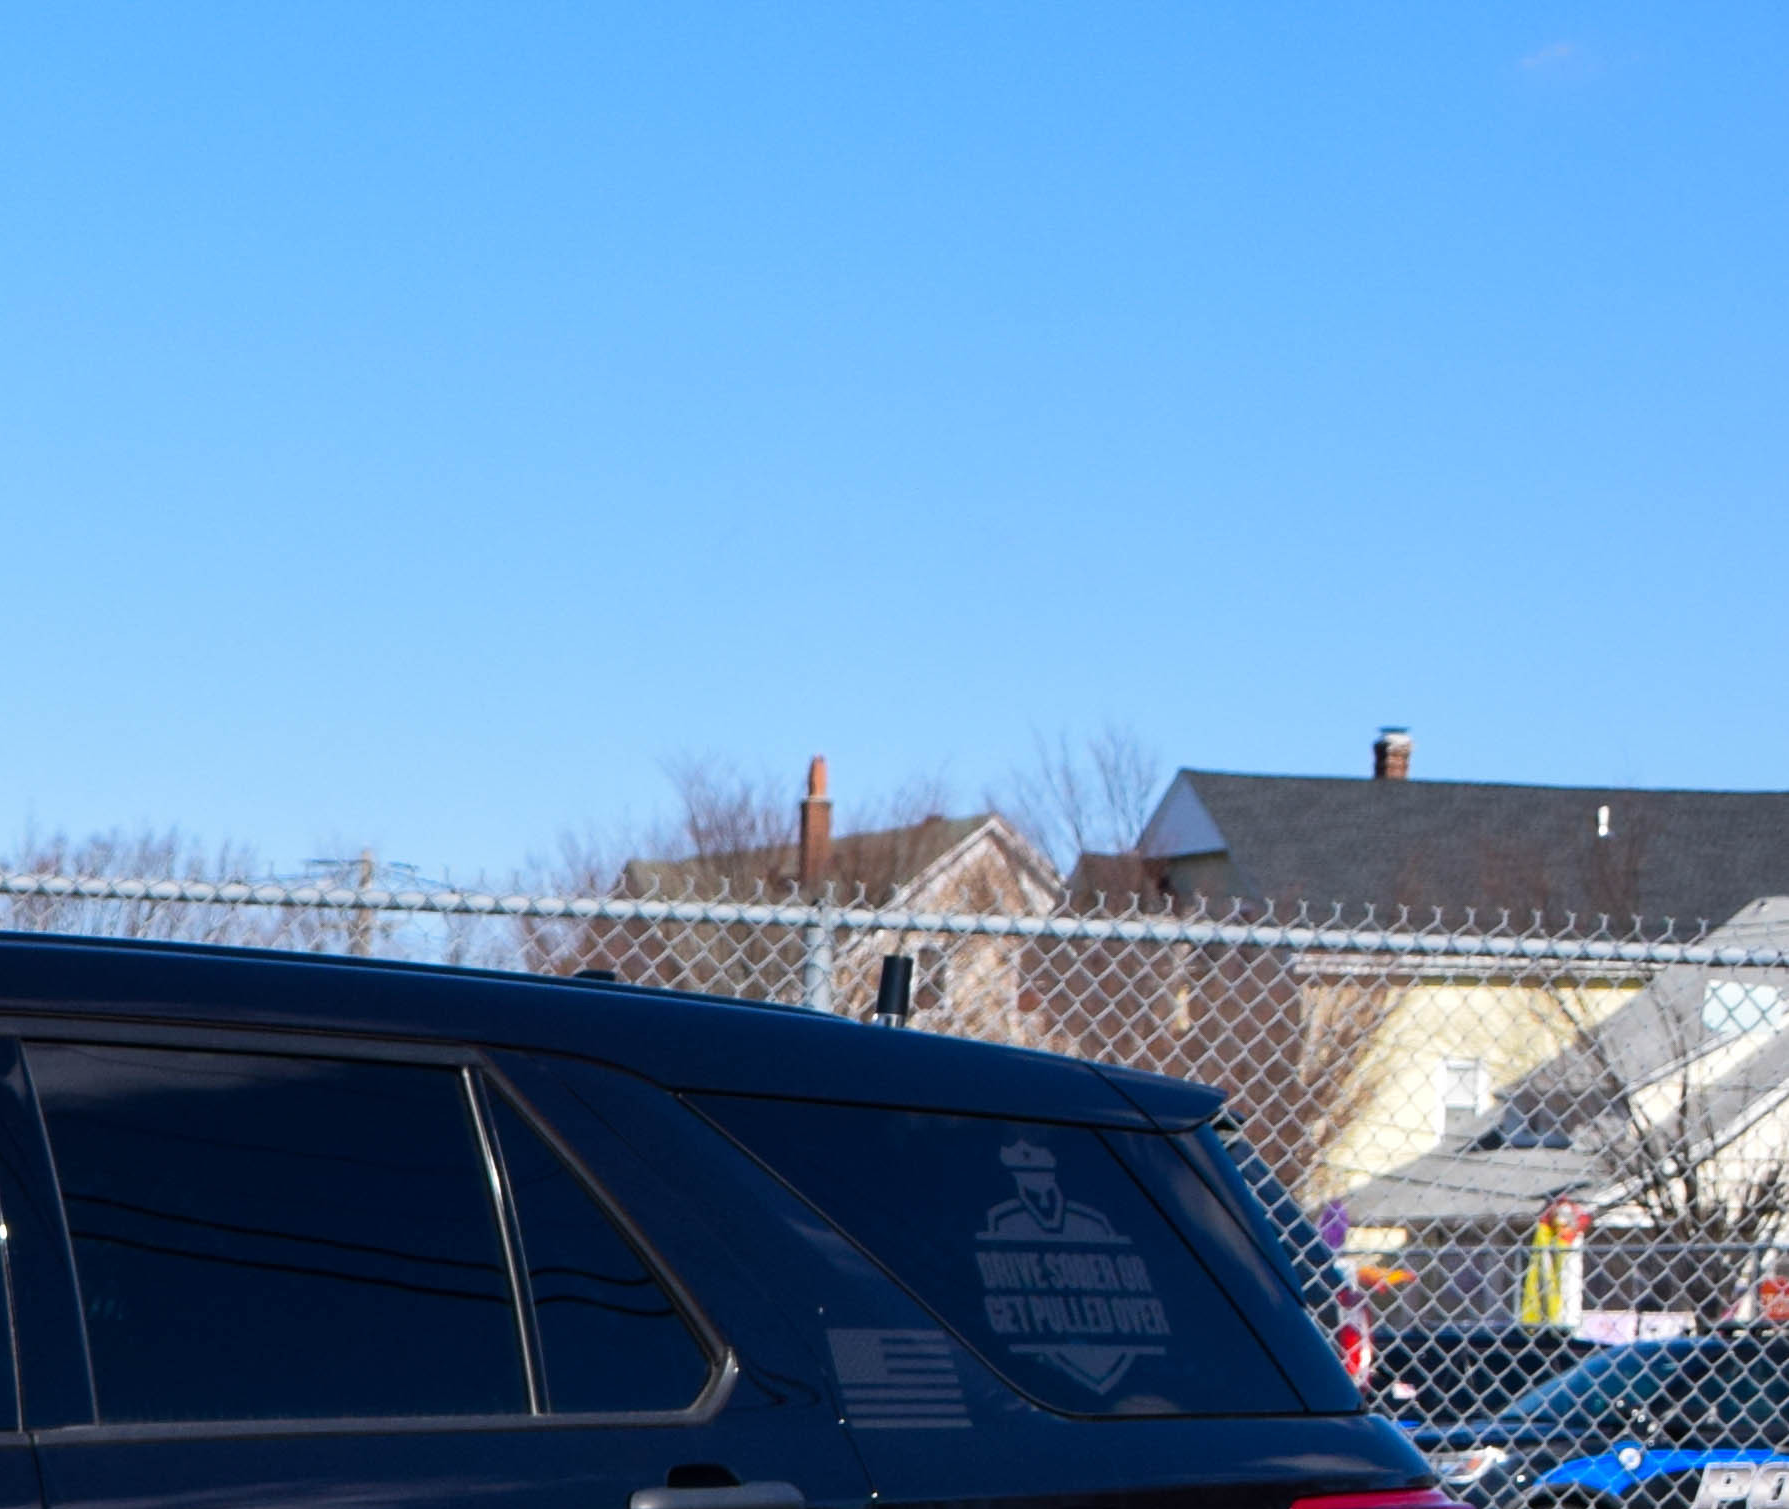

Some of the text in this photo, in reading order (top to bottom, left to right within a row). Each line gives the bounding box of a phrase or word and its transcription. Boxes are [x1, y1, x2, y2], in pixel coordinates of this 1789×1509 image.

[975, 1251, 1047, 1290] DRIVE
[984, 1295, 1172, 1336] GET PULLED OVER
